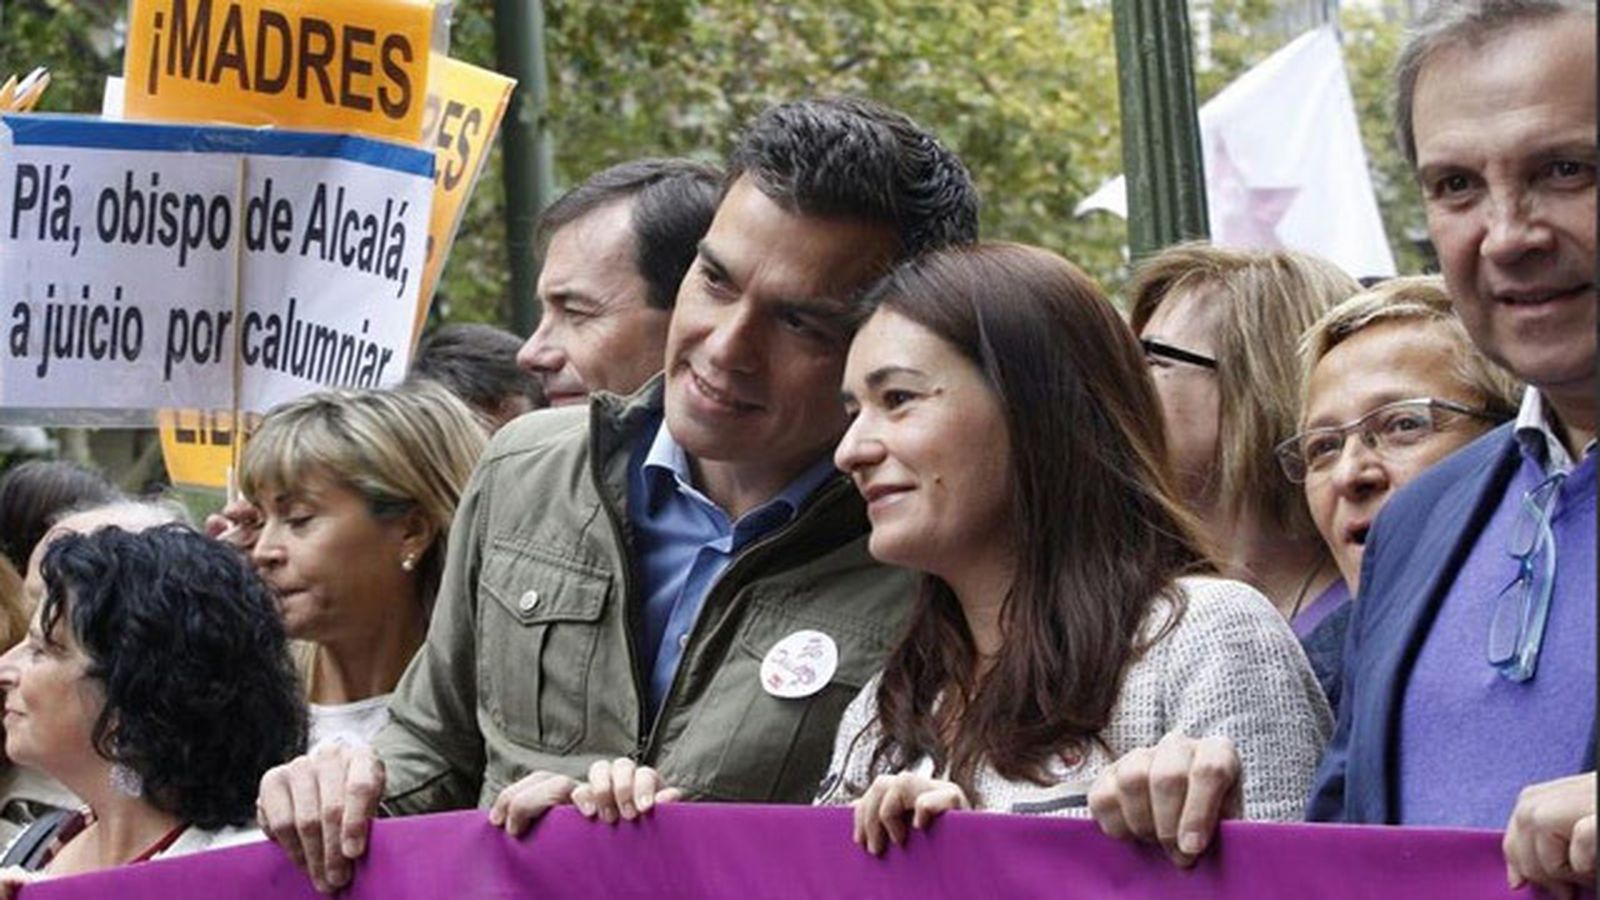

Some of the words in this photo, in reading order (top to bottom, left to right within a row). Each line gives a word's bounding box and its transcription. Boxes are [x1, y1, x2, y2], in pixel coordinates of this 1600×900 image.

[147, 0, 415, 120] ¡MADRES
[10, 163, 80, 257] Plá,
[97, 170, 231, 267] obispo
[245, 179, 293, 253] de
[300, 183, 409, 298] Alcalá,
[10, 302, 31, 357] a
[37, 284, 143, 378] juicio
[164, 308, 233, 381] por
[241, 297, 393, 389] calumniar
